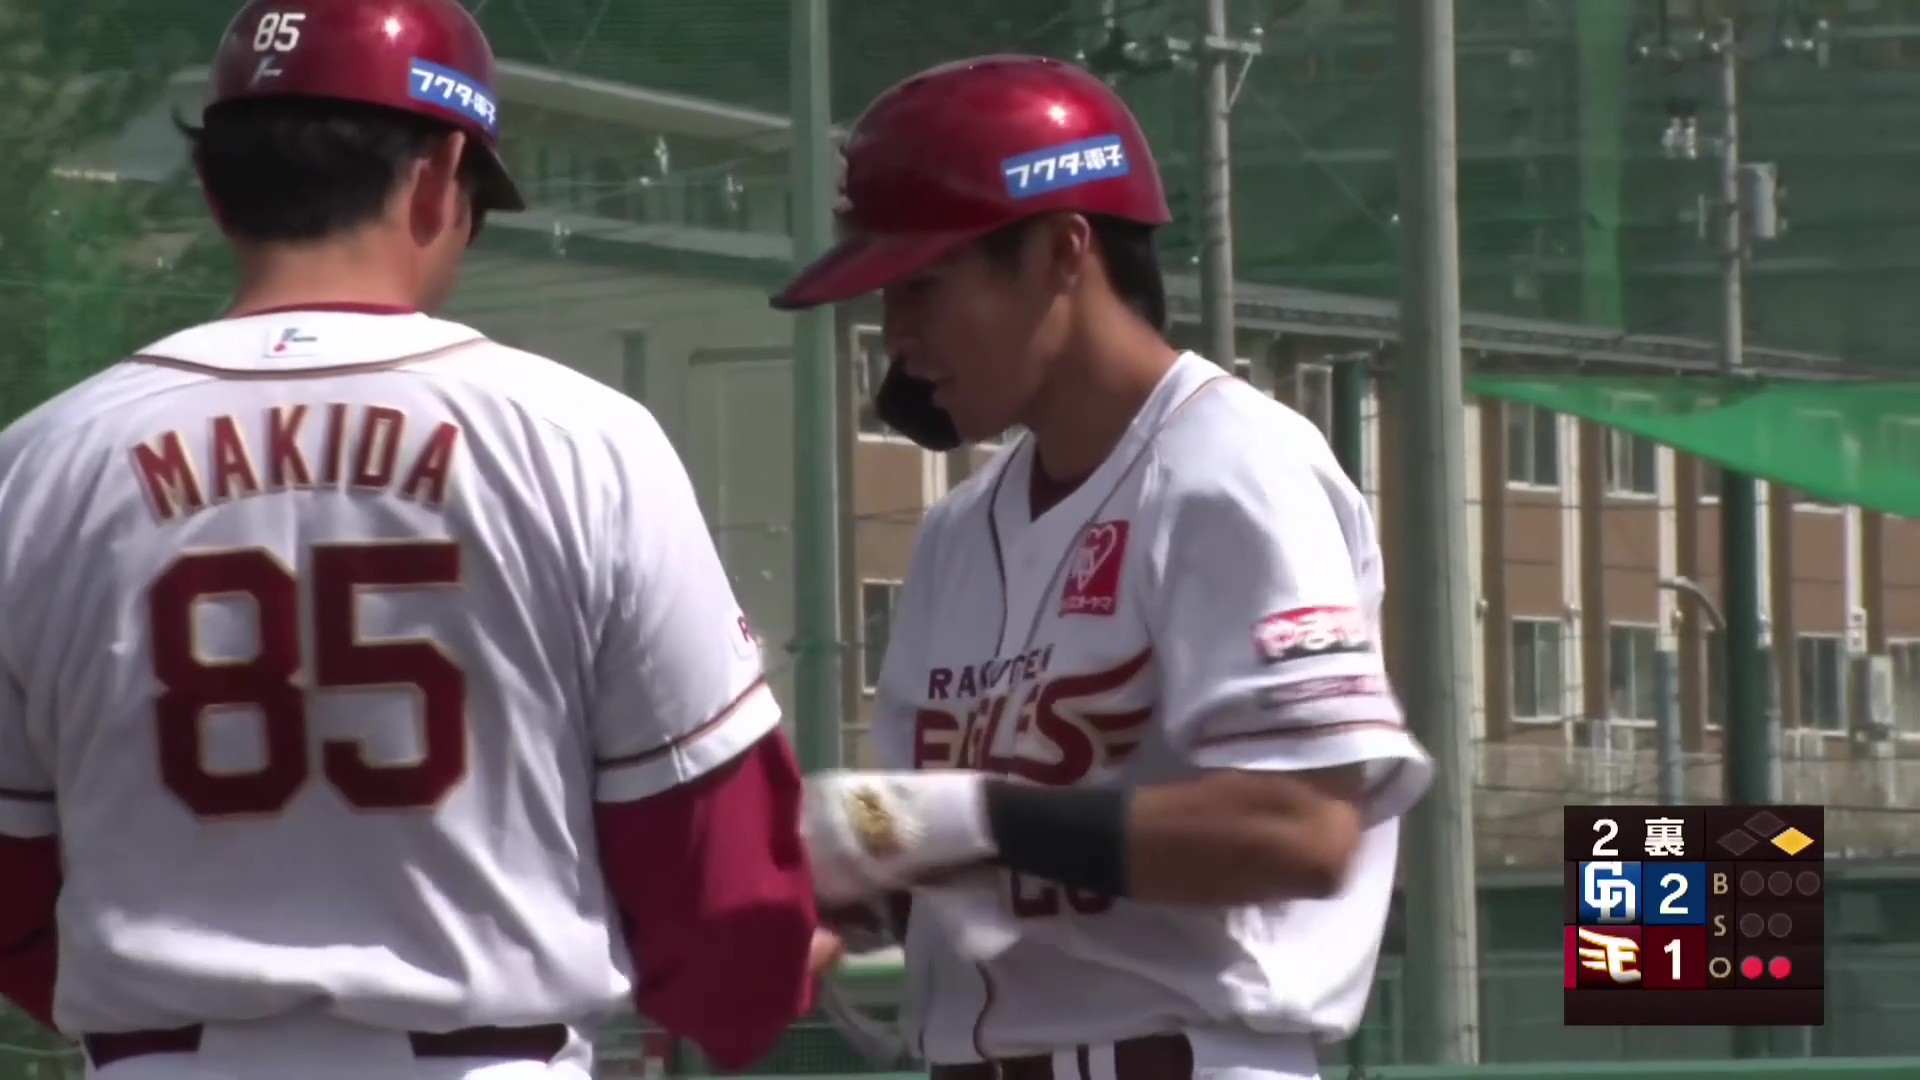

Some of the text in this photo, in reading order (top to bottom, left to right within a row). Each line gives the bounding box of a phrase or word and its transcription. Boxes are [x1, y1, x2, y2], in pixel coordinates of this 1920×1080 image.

[253, 12, 306, 51] 85
[130, 402, 461, 527] MAKIDA
[149, 537, 470, 821] 85
